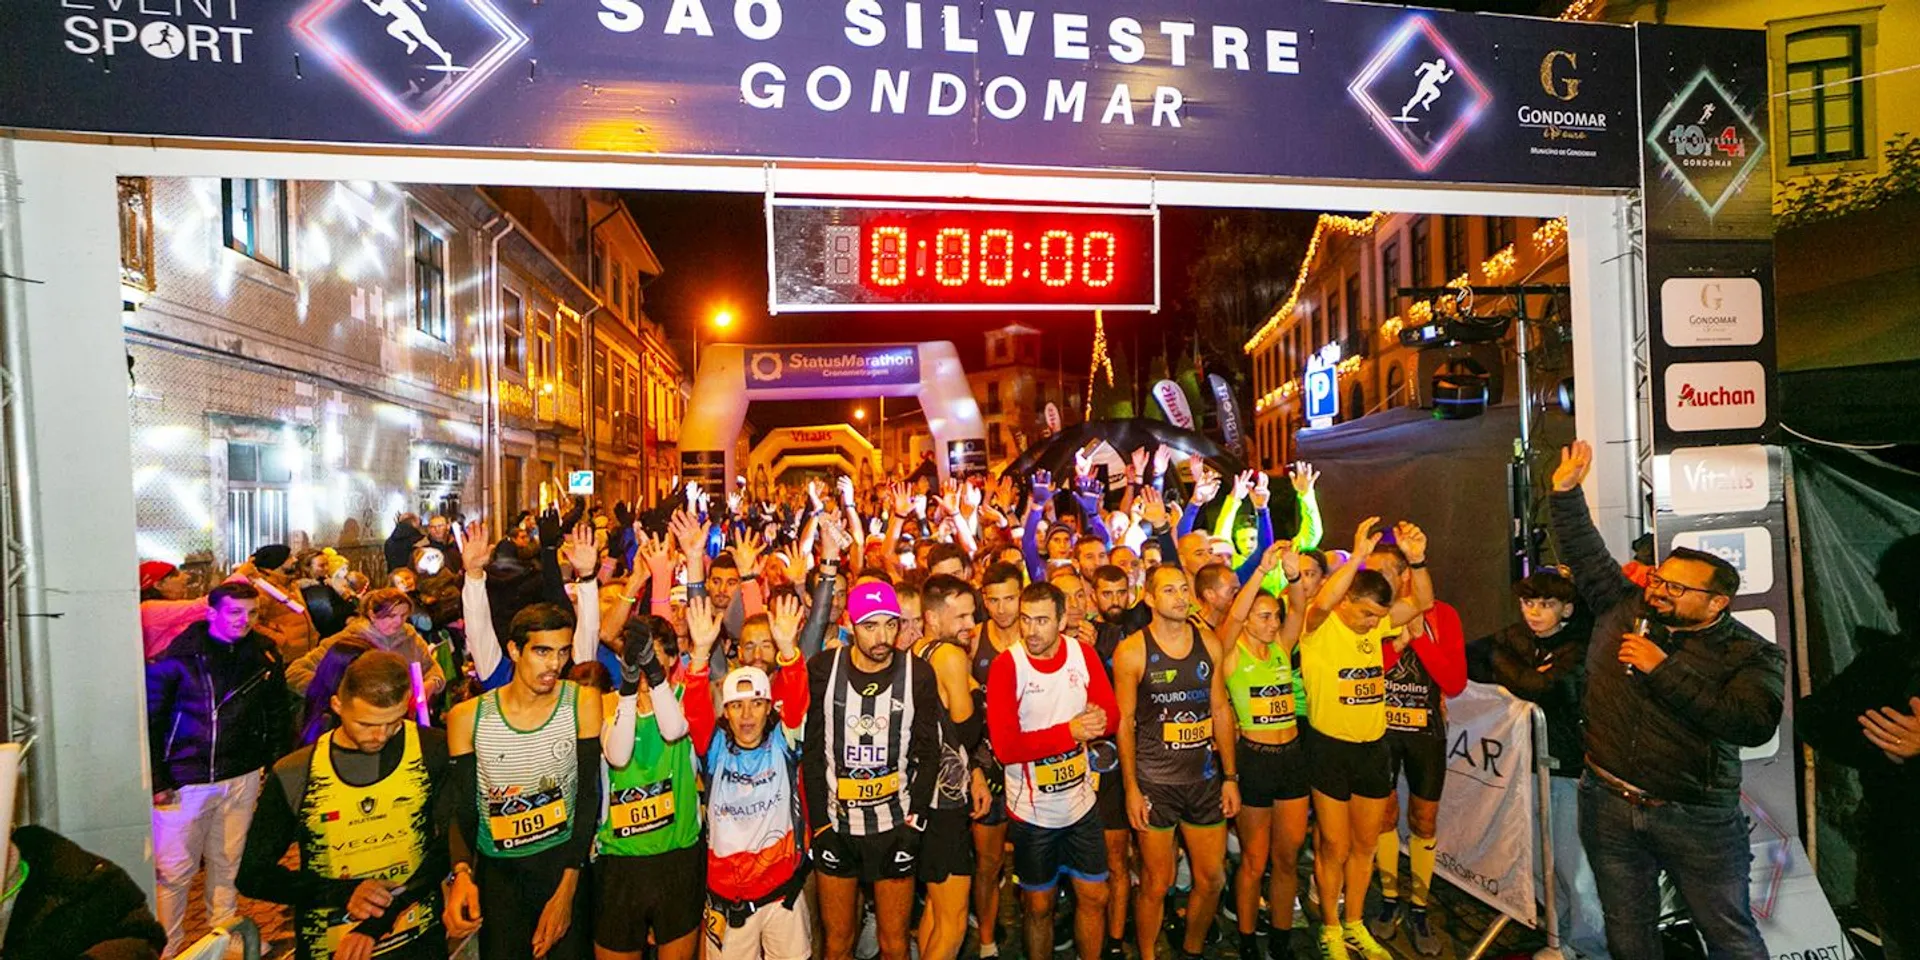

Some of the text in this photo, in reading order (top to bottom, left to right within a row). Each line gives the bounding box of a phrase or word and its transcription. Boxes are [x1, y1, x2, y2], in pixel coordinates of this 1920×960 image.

[64, 15, 253, 63] SPORT
[844, 0, 1300, 74] SILVESTRE
[1540, 51, 1582, 100] G
[740, 61, 1184, 128] GONDOMAR
[871, 225, 1116, 288] 0:00:00
[789, 352, 914, 368] StatusMarathon
[1310, 371, 1330, 414] P
[1678, 383, 1755, 408] Auchan
[1684, 459, 1755, 492] Vitalis
[1053, 764, 1075, 782] 738
[858, 783, 883, 798] 792
[512, 814, 545, 836] 769
[630, 804, 657, 823] 641
[331, 828, 408, 851] VEGAS
